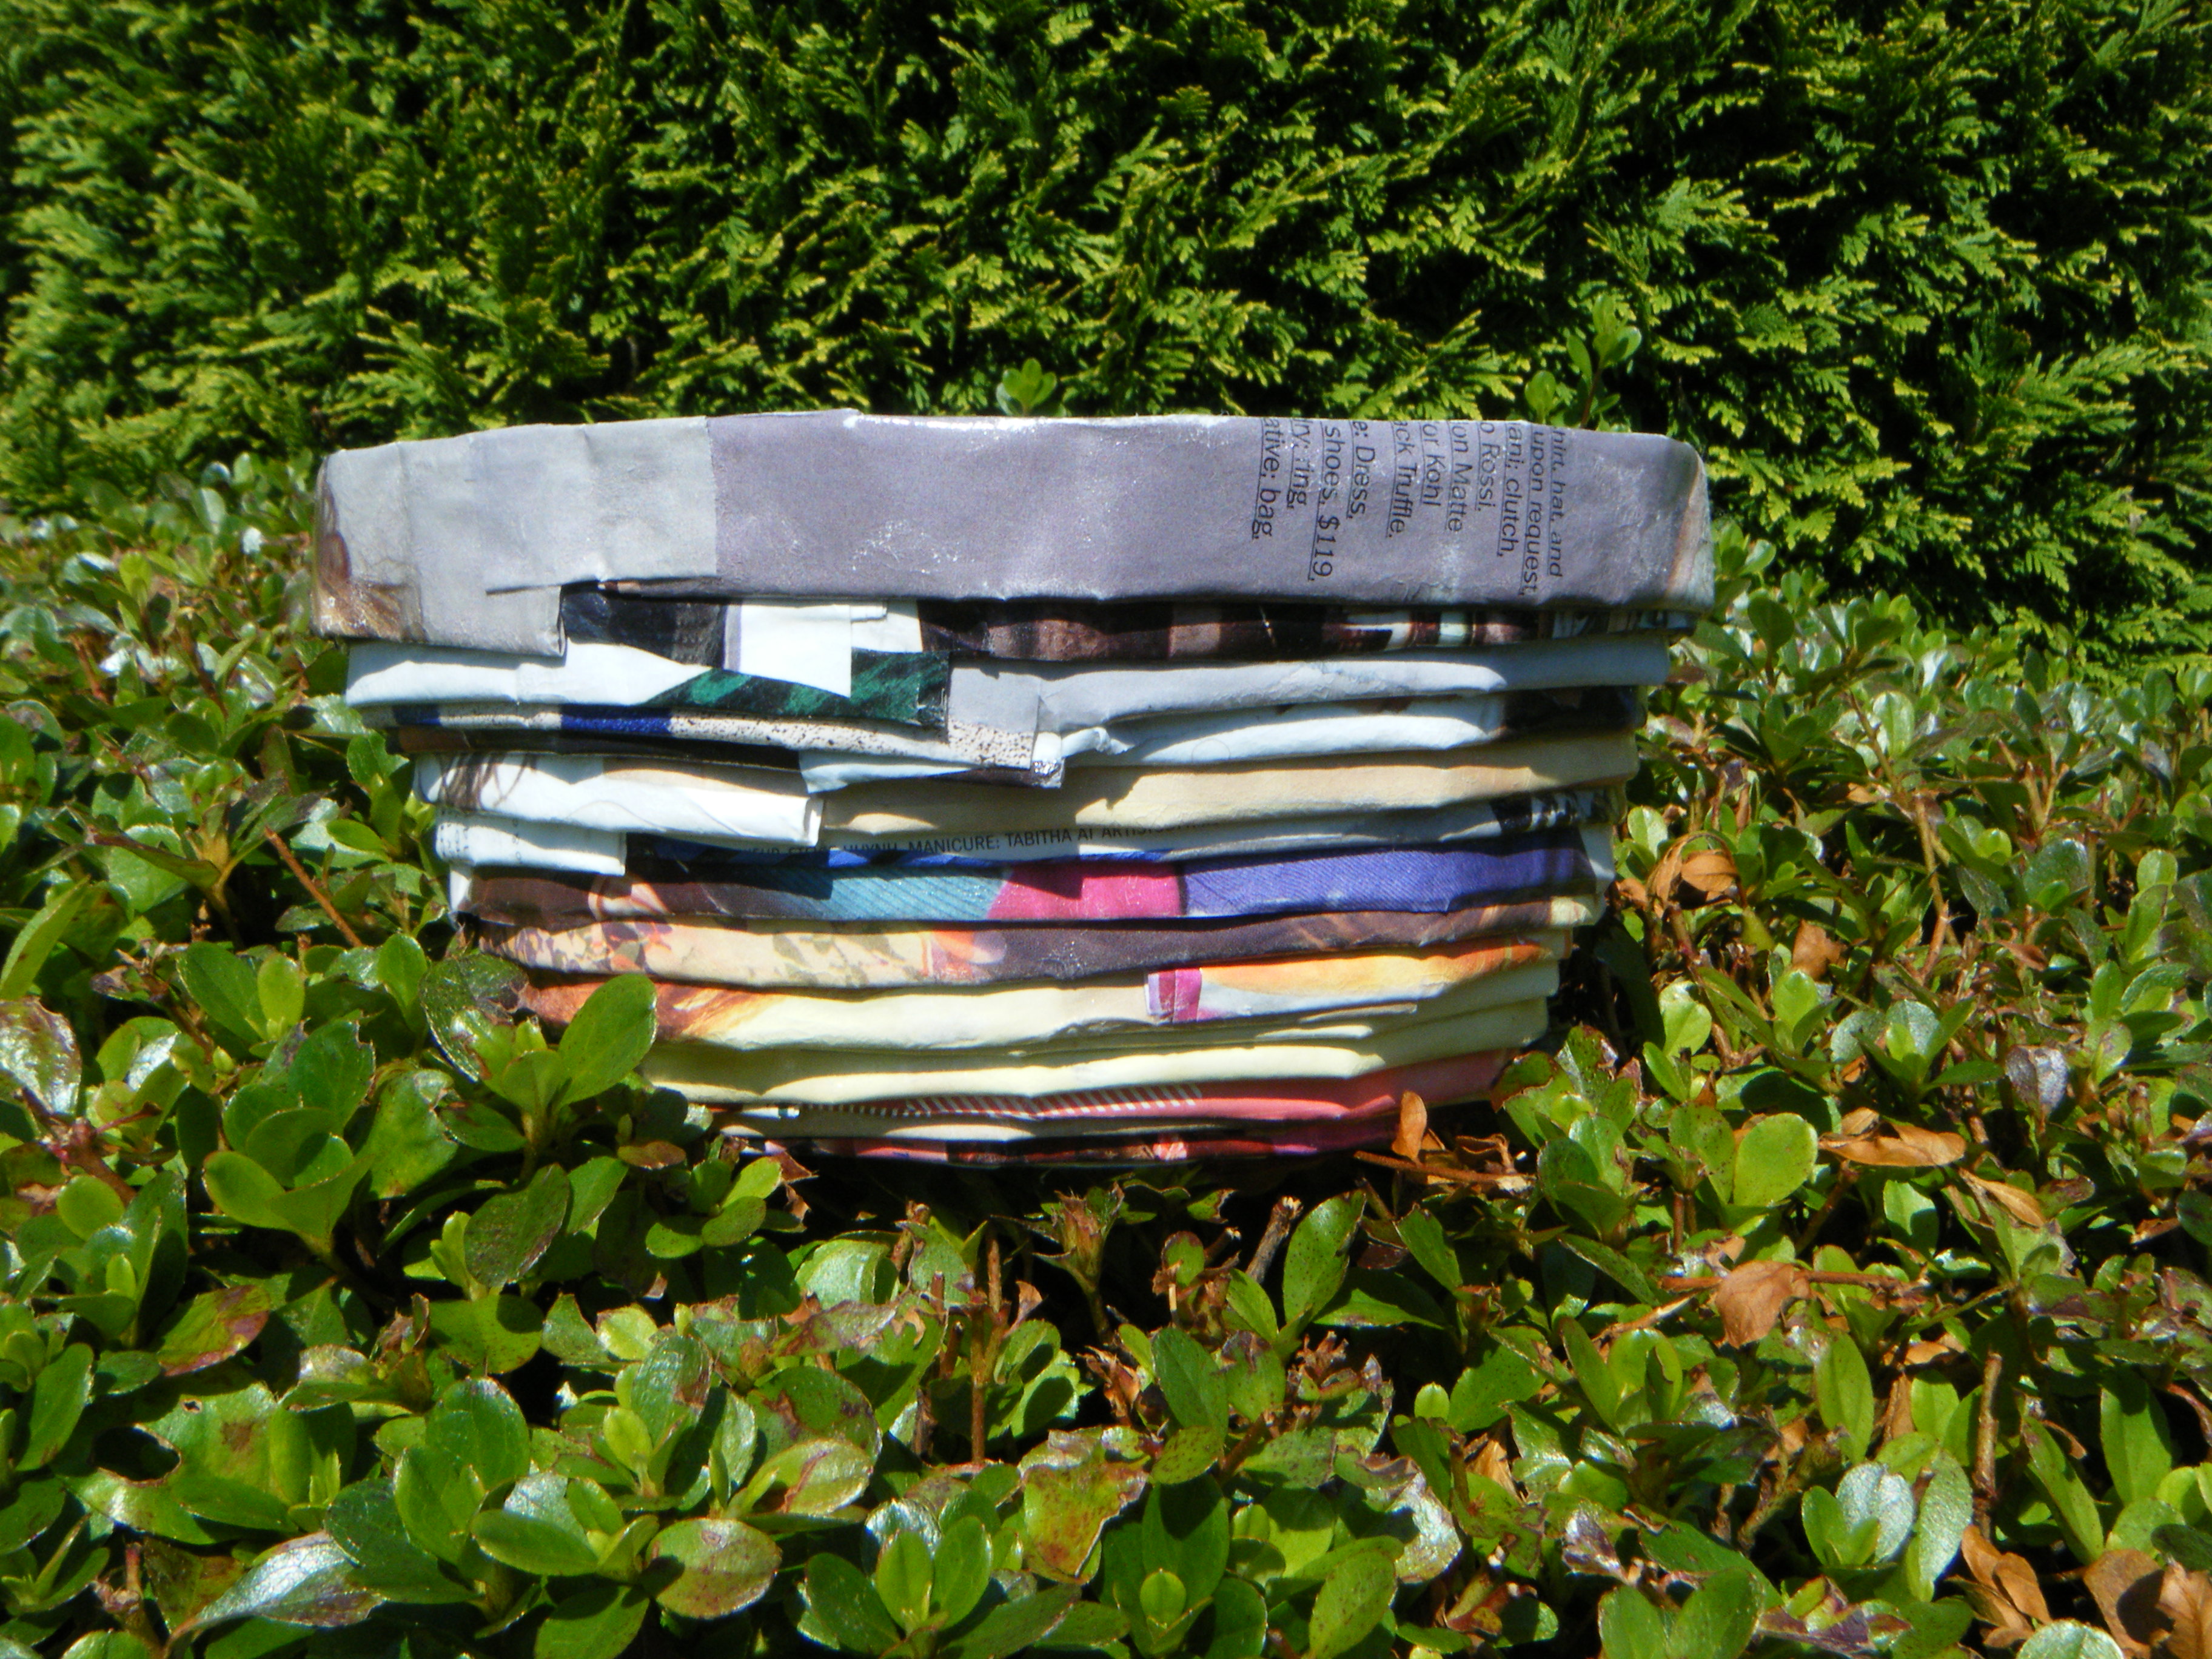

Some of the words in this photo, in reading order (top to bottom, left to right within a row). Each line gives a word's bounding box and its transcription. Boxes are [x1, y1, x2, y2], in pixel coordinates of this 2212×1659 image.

[1318, 426, 1346, 506] shoes,
[1476, 443, 1501, 512] Rossi.
[1505, 423, 1524, 469] ani;
[1530, 431, 1544, 492] upon
[1552, 426, 1566, 471] hirt,
[1286, 458, 1315, 509] ring,
[1346, 446, 1375, 520] Dress,
[1389, 462, 1418, 538] Truffle.
[1423, 455, 1446, 507] Kohl
[1447, 463, 1473, 532] Matte
[1251, 488, 1281, 540] bag,
[1497, 478, 1523, 557] clutch,
[1307, 515, 1341, 581] $119,
[1518, 501, 1543, 595] request,
[1549, 532, 1563, 577] and
[908, 834, 1000, 854] MANICURE:
[1005, 828, 1073, 848] TABITHA
